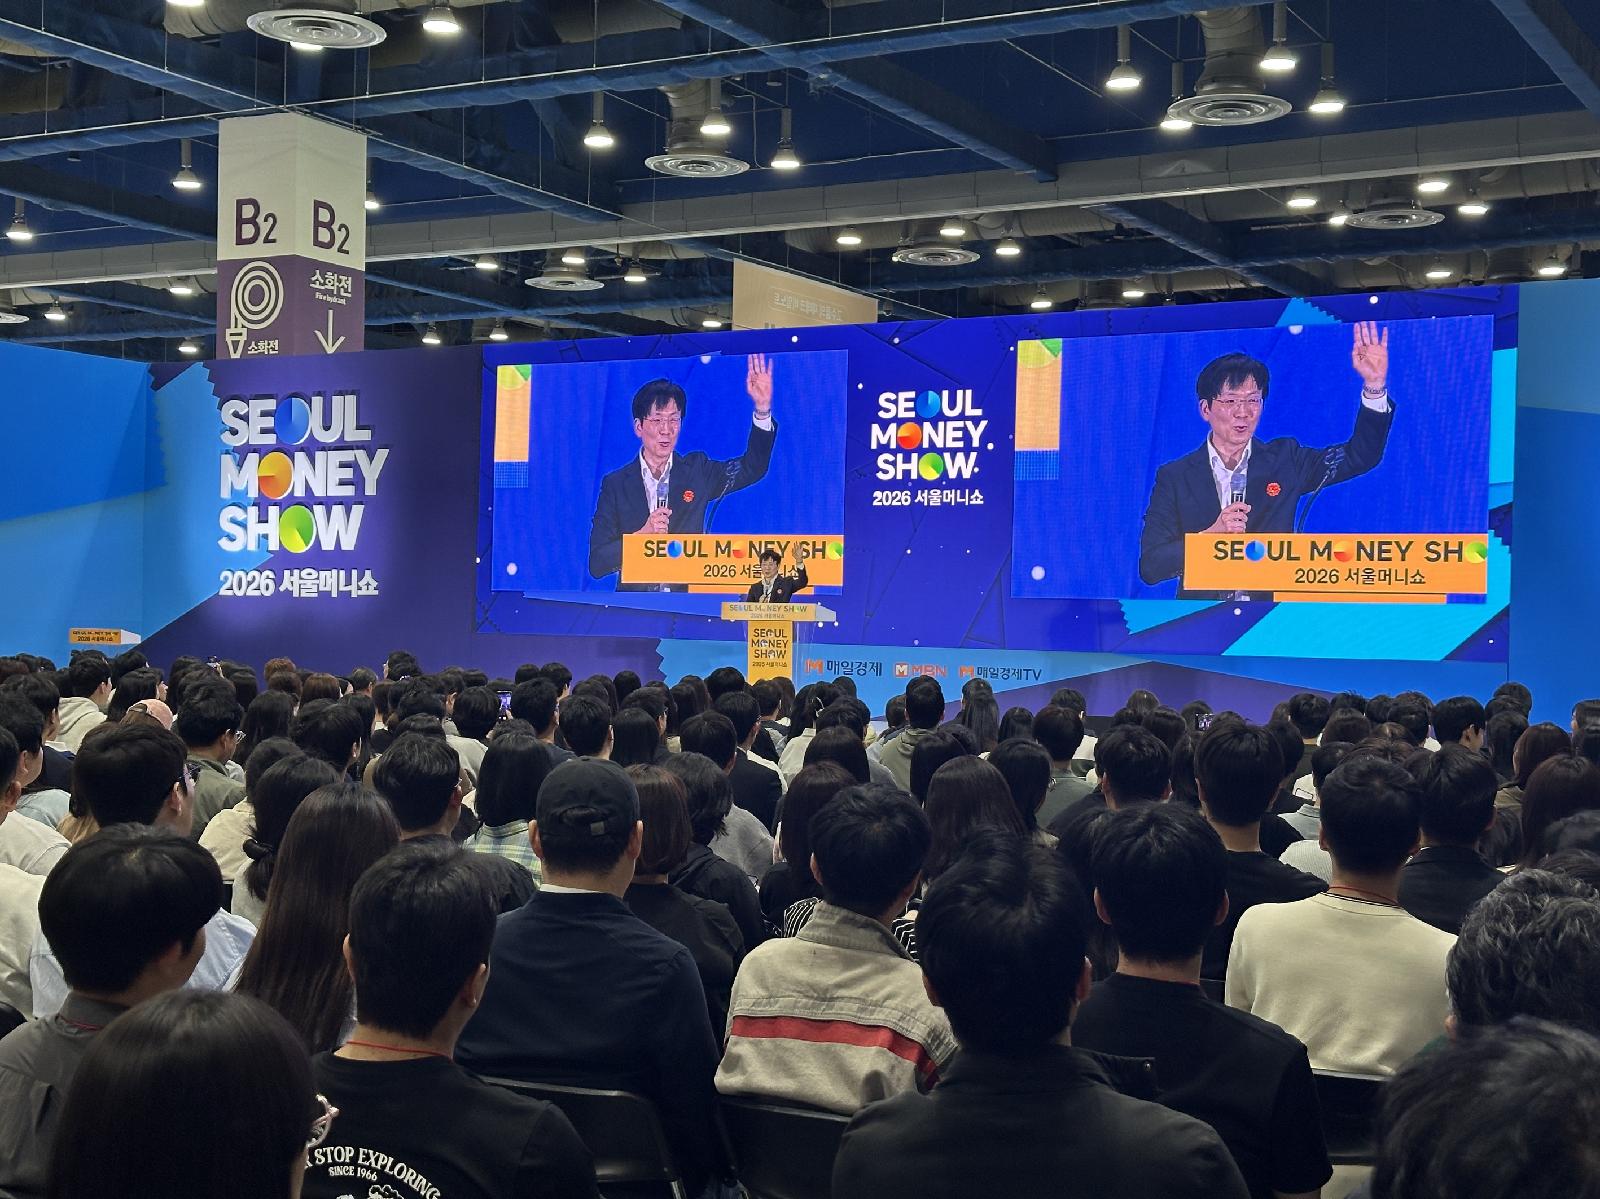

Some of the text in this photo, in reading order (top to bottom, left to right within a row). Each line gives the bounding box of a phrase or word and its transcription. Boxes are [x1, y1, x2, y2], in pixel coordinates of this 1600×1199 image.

[235, 198, 278, 246] B2
[312, 199, 350, 255] B2
[309, 269, 352, 298] 소화전
[247, 339, 279, 354] 소화전
[878, 389, 983, 419] SEOUL
[220, 395, 372, 446] SEOUL
[870, 420, 988, 450] MONEY
[220, 448, 390, 500] MONEY
[876, 452, 977, 481] SHOW
[872, 489, 984, 506] 2026 서울머니쇼
[217, 504, 365, 553] SHOW
[643, 540, 708, 559] SEOUL
[1213, 540, 1300, 562] SEOUL
[1310, 540, 1414, 562] MONEY
[703, 563, 799, 579] 2026 서울니쇼
[1294, 567, 1426, 586] 2026 서울머니쇼
[218, 567, 379, 598] 2026 서울머니쇼
[753, 628, 788, 638] SEOUL
[751, 639, 789, 648] MONEY
[754, 649, 787, 659] SHOW
[826, 660, 883, 677] 매일경제
[911, 664, 947, 677] MBN
[976, 665, 1042, 681] 매일경제TV
[314, 1146, 354, 1165] STOP
[358, 1147, 441, 1199] EXPLORING
[328, 1165, 378, 1182] SINCE 1966
